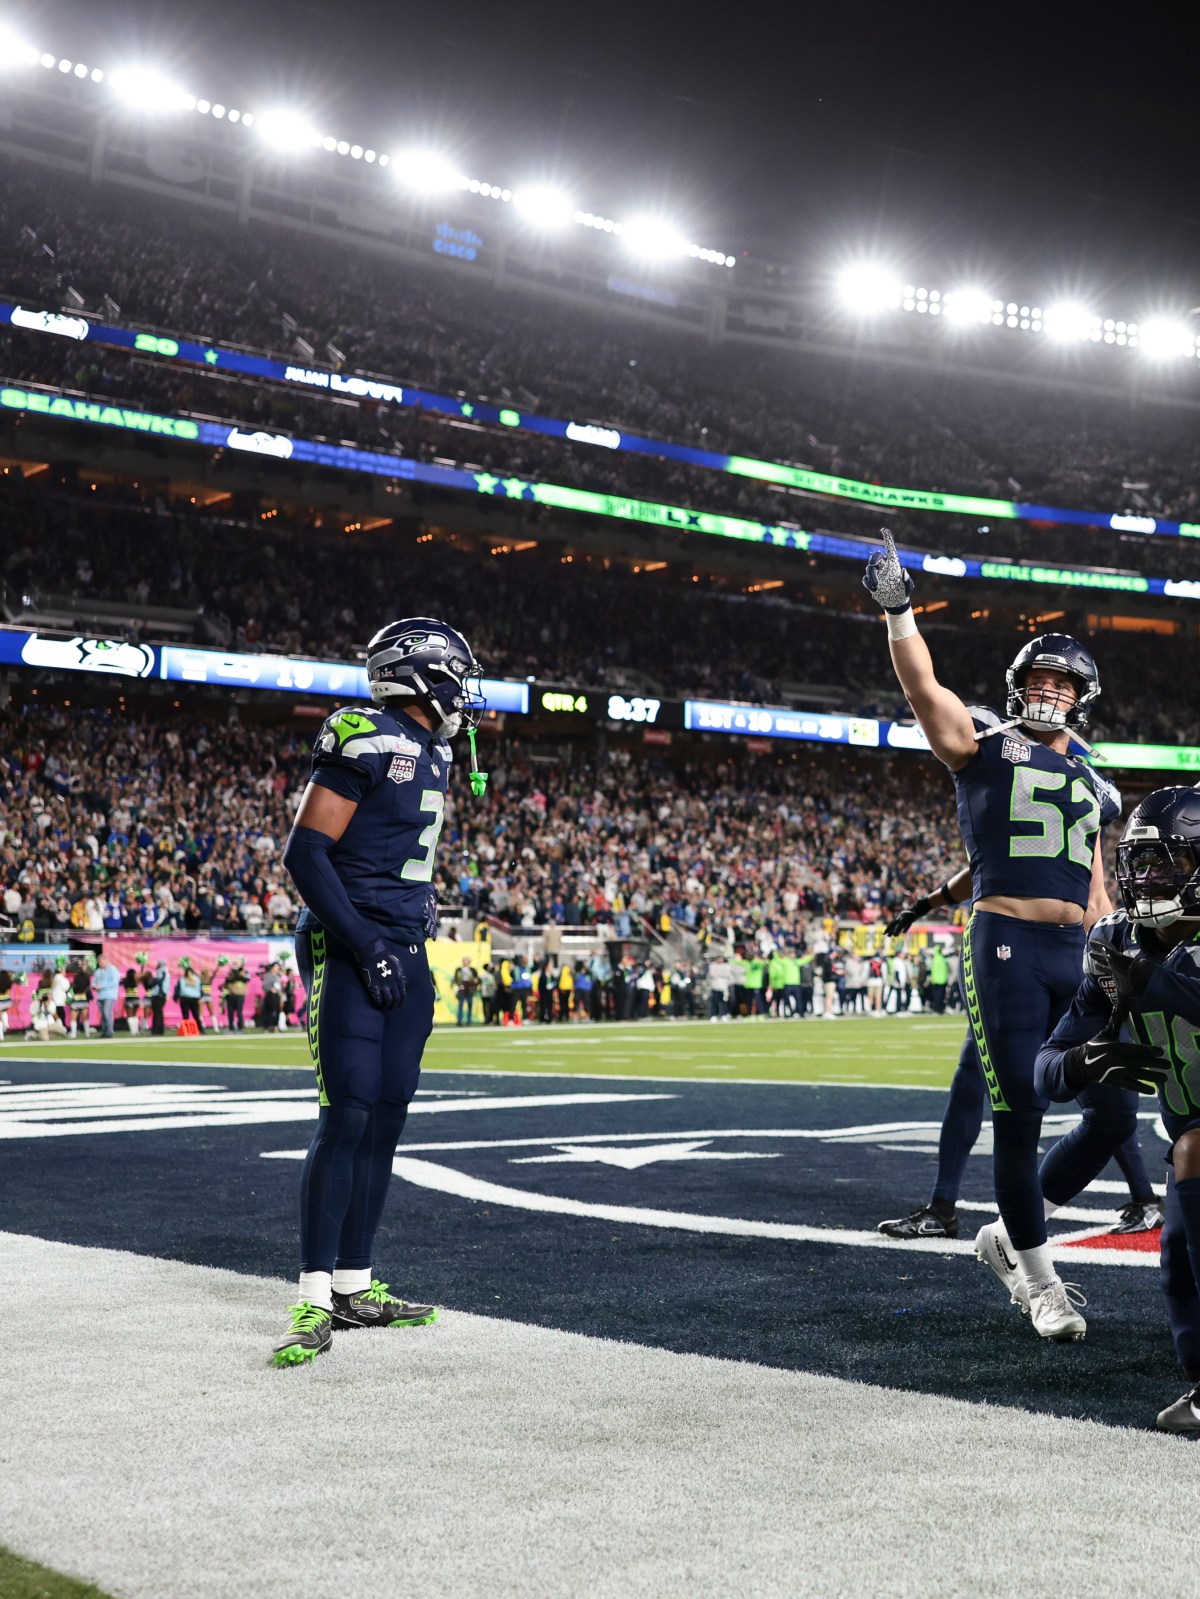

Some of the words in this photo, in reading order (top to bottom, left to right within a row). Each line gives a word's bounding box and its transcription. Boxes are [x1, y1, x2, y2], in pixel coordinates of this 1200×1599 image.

[134, 333, 179, 356] 20
[284, 366, 329, 388] JULIAN
[0, 388, 199, 439] SEAHAWKS
[837, 482, 945, 506] SEAHAWKS
[667, 510, 701, 526] LX
[981, 562, 1030, 581] SEATTLE
[1030, 567, 1149, 592] SEAHAWKS
[276, 662, 314, 689] 19
[541, 692, 574, 711] QTR
[574, 696, 588, 713] 4
[608, 695, 661, 723] 8:37
[699, 706, 735, 729] 1ST
[735, 713, 746, 728] &
[748, 712, 773, 733] 10
[1003, 749, 1029, 760] 250
[1006, 740, 1028, 751] USA
[389, 769, 412, 780] 250
[393, 758, 413, 768] USA
[1009, 766, 1101, 871] 52
[400, 789, 445, 882] 3
